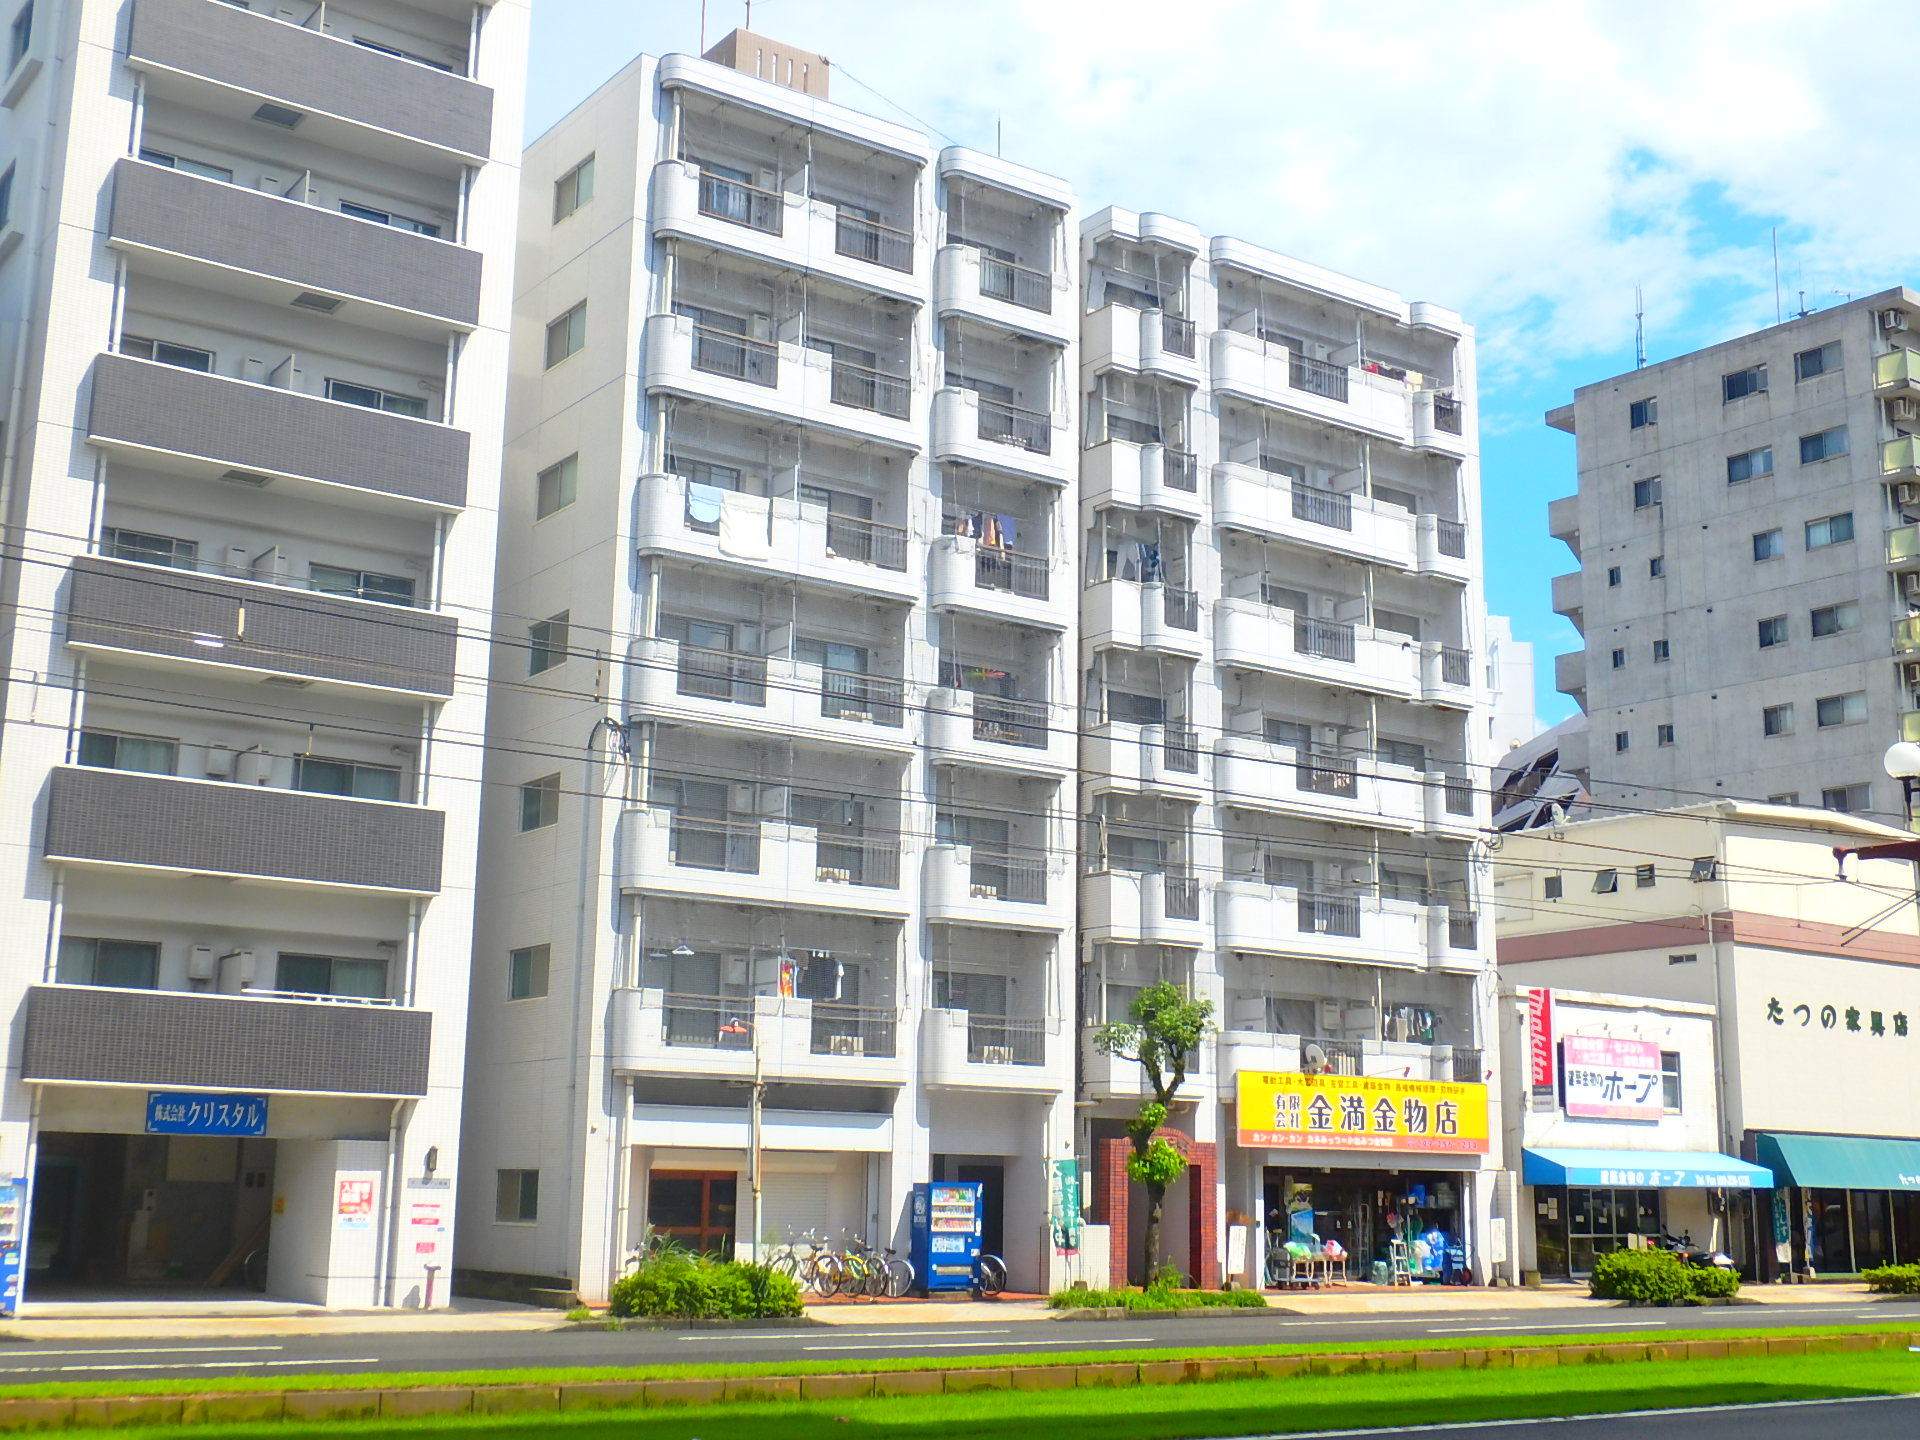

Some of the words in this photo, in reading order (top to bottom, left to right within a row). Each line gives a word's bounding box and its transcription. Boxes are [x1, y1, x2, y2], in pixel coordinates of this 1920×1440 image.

[1766, 997, 1909, 1037] たつの家具店
[1276, 1094, 1300, 1111] 有限
[1308, 1094, 1457, 1135] 金満金物店
[1276, 1111, 1300, 1128] 会社
